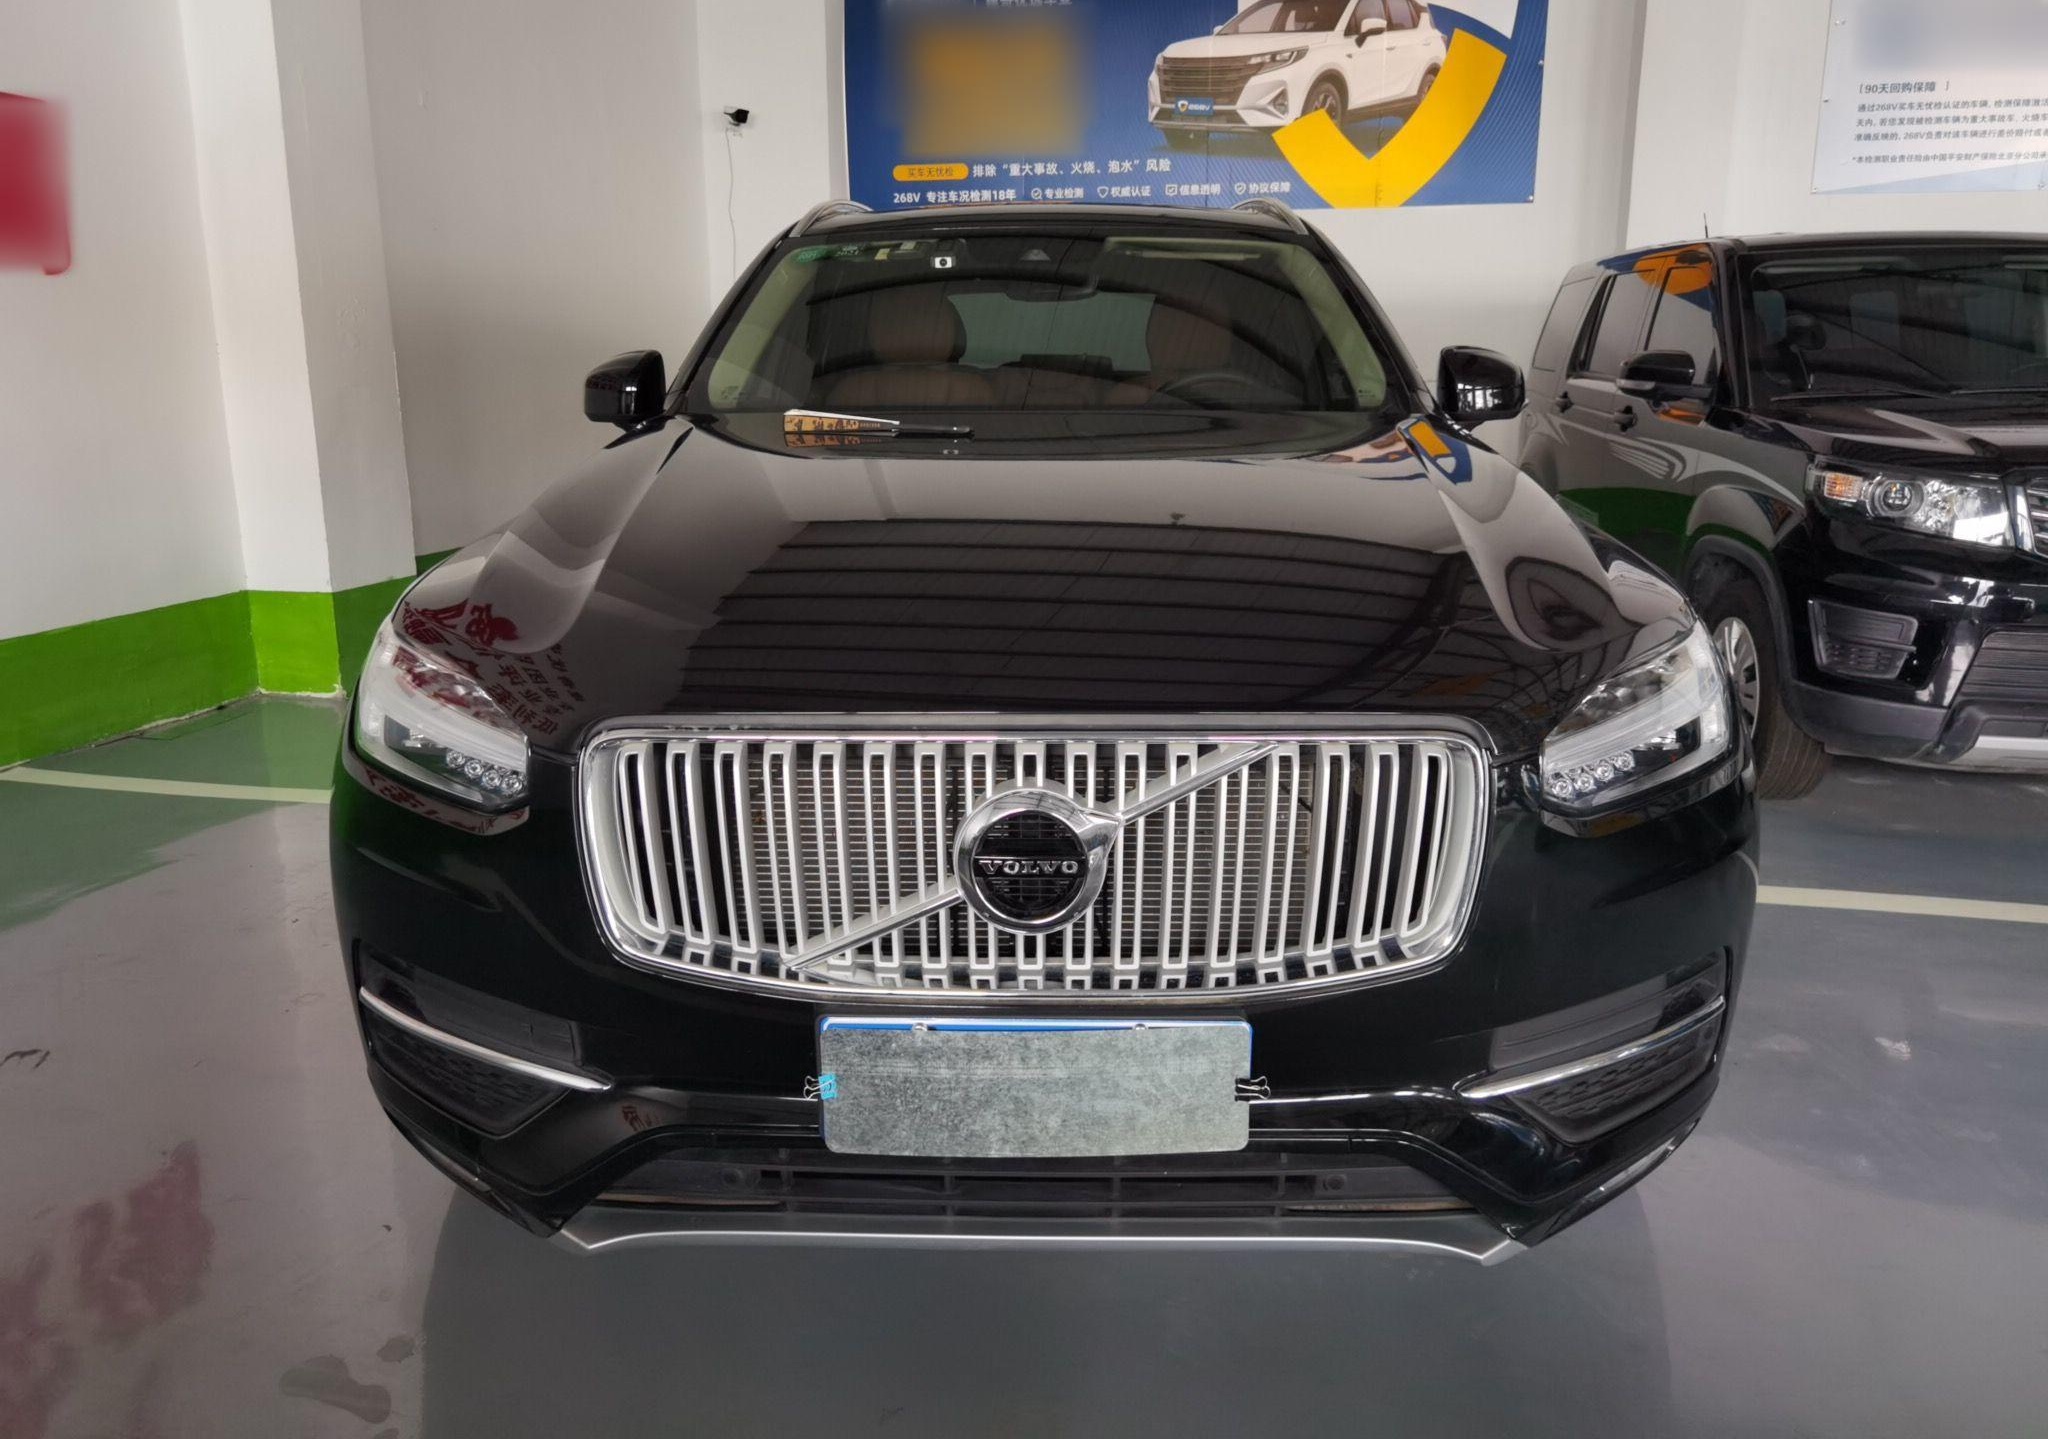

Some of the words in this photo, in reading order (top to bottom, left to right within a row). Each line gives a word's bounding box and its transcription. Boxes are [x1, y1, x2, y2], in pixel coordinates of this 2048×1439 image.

[908, 166, 954, 178] 买车无忧检
[1044, 188, 1084, 200] 专业检测
[1111, 185, 1151, 198] 权威认证
[1180, 183, 1221, 196] 信息透明
[1249, 181, 1291, 194] 协议保障
[893, 192, 921, 204] 268V
[926, 188, 1016, 204] 专注车况检测18年
[978, 860, 1079, 875] VOLVO
